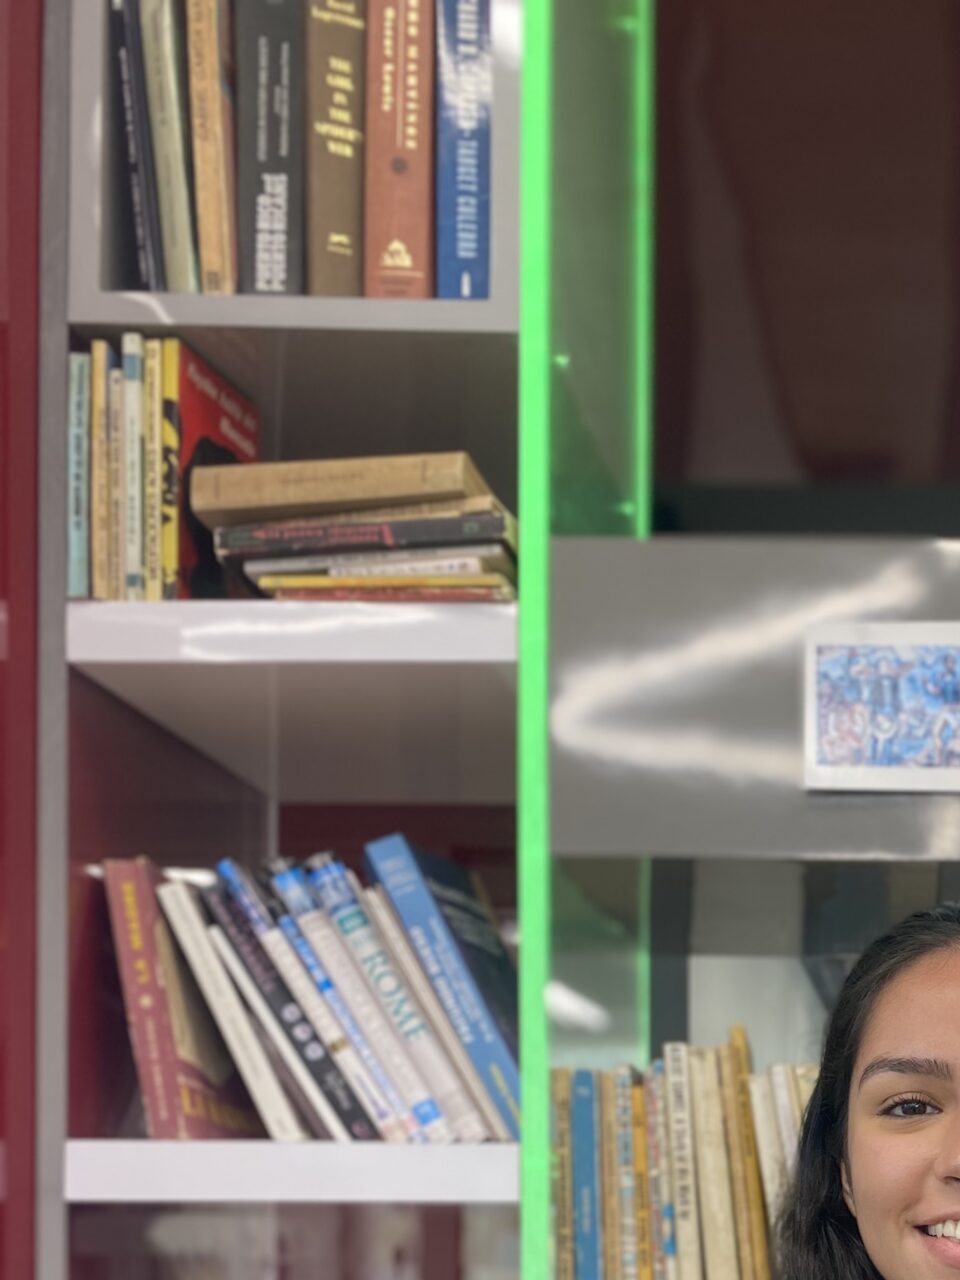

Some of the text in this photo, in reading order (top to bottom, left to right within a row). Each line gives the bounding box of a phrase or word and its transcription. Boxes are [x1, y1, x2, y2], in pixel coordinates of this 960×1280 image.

[328, 56, 352, 74] THE
[381, 7, 395, 112] Oscar Lewis
[328, 106, 352, 125] THE
[326, 140, 353, 158] WEB
[457, 139, 478, 191] TARGET
[457, 195, 478, 259] CULEBRA
[363, 951, 429, 1040] ROME
